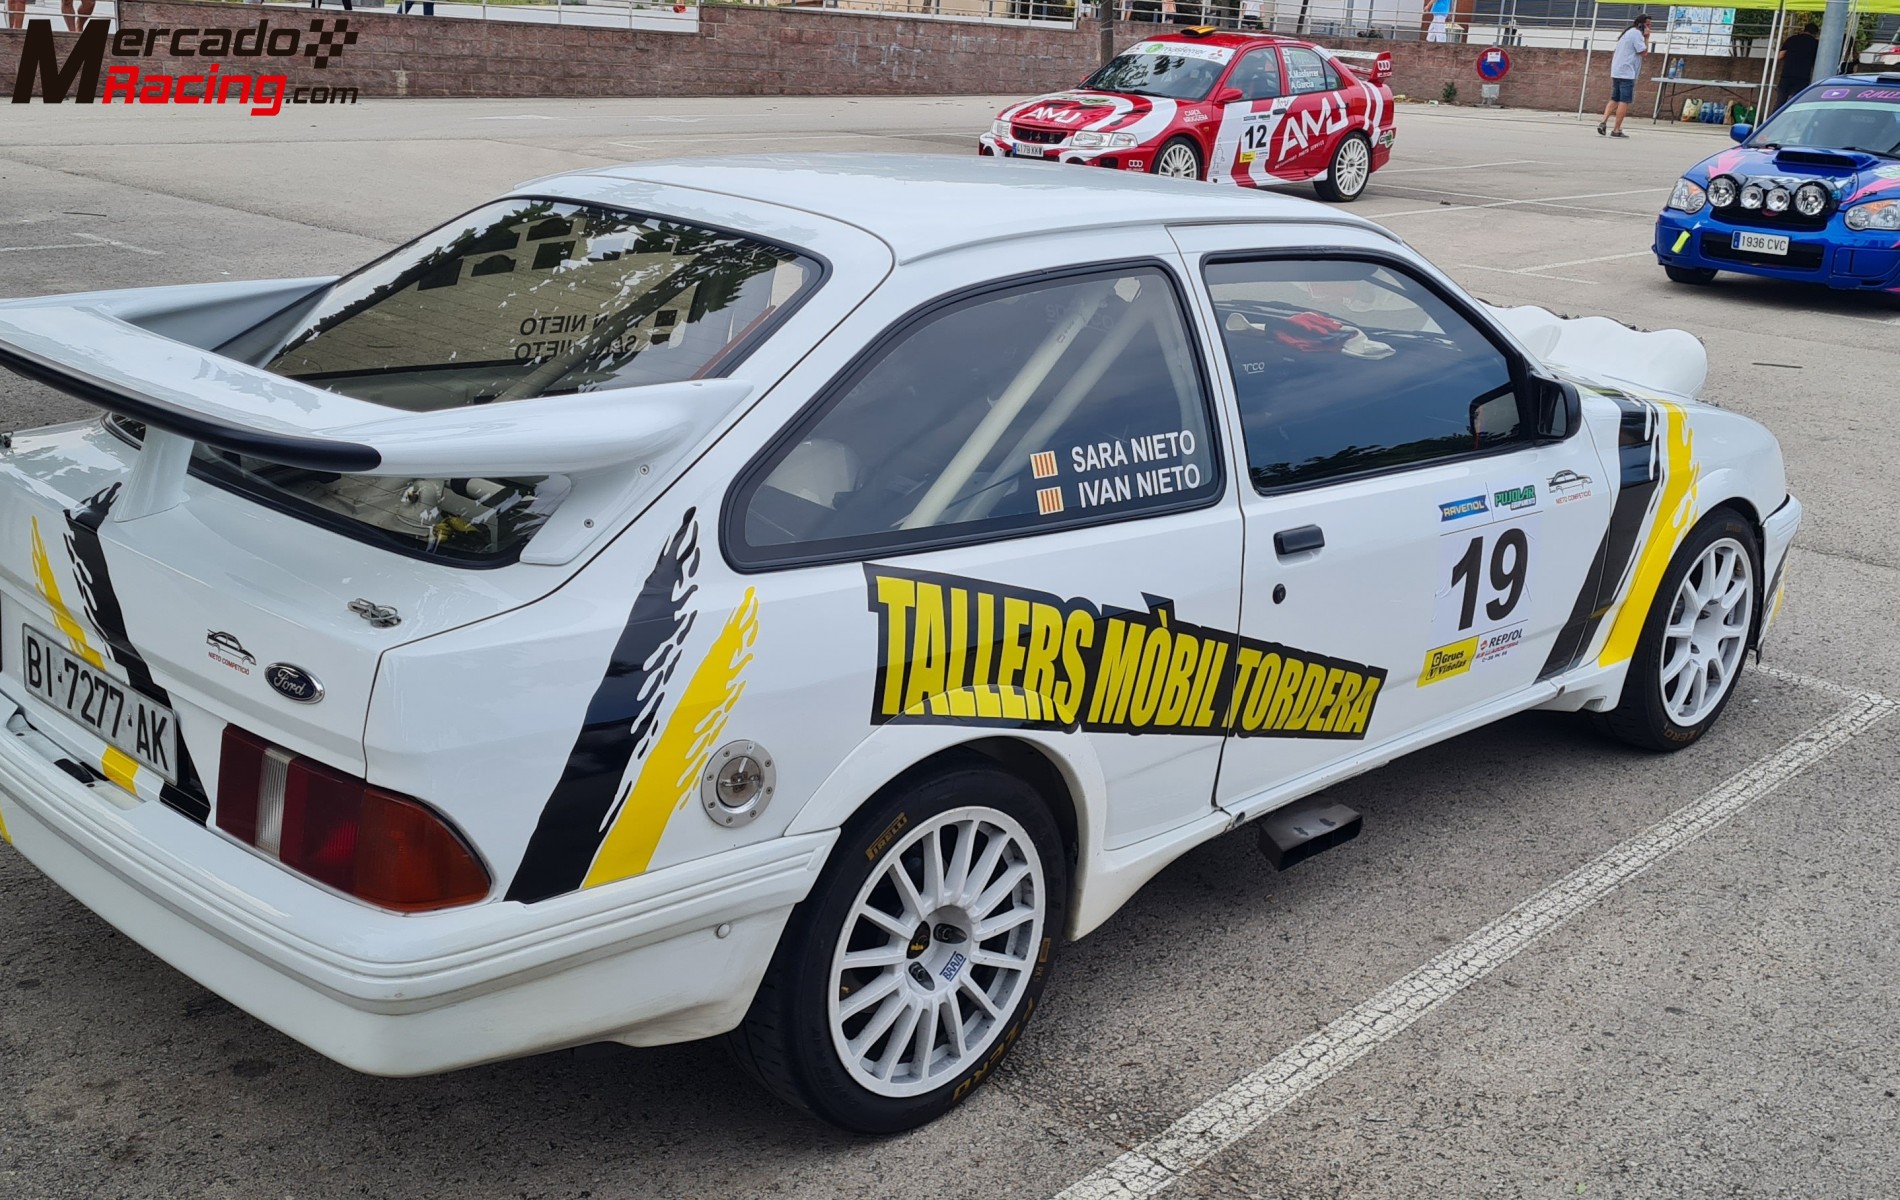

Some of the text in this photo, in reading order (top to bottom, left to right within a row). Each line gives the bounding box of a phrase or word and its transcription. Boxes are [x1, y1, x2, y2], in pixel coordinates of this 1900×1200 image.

[1244, 124, 1268, 150] 12
[1742, 235, 1787, 251] 1936 CVC
[1071, 430, 1196, 473] SARA NIETO
[1078, 463, 1201, 508] IVAN NIETO
[1494, 485, 1537, 507] PUJOLAR
[1443, 500, 1486, 518] RAVENOL
[1451, 527, 1529, 632] 19
[1488, 628, 1523, 648] REPSOL
[208, 651, 250, 676] NIETO COMPETICIÓ
[875, 575, 1381, 734] TALLERS MÒBIL TORDERA
[1442, 650, 1465, 664] Grues
[274, 668, 306, 696] Ford
[942, 953, 964, 981] BRAID
